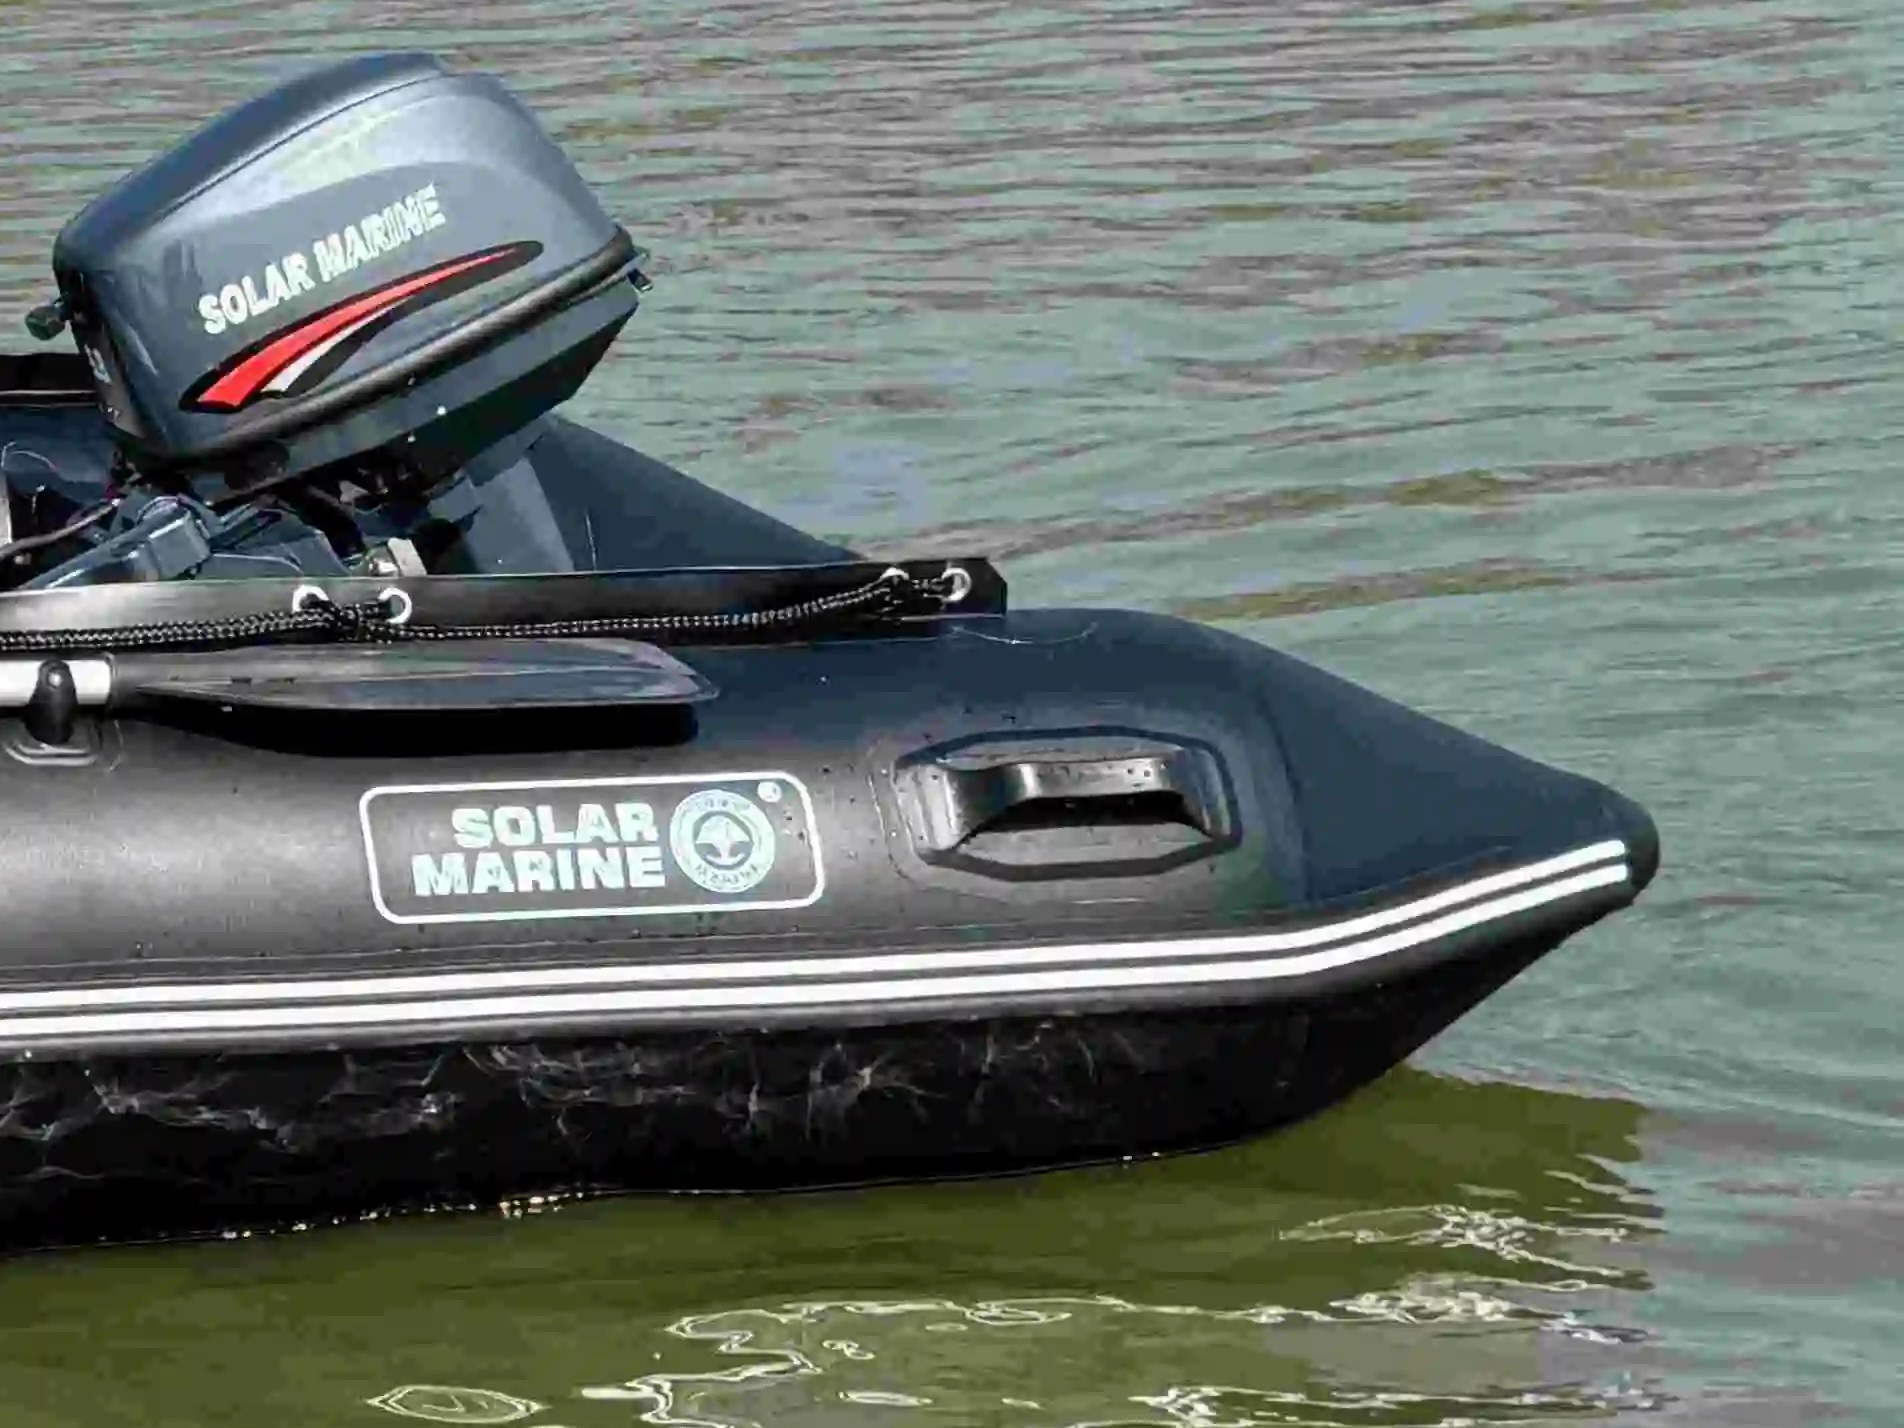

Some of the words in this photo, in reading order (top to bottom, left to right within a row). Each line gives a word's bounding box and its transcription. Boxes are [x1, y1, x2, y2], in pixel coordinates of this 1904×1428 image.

[198, 252, 316, 335] SOLAR
[313, 182, 447, 282] MARINE
[450, 802, 659, 849] SOLAR
[411, 845, 667, 897] MARINE
